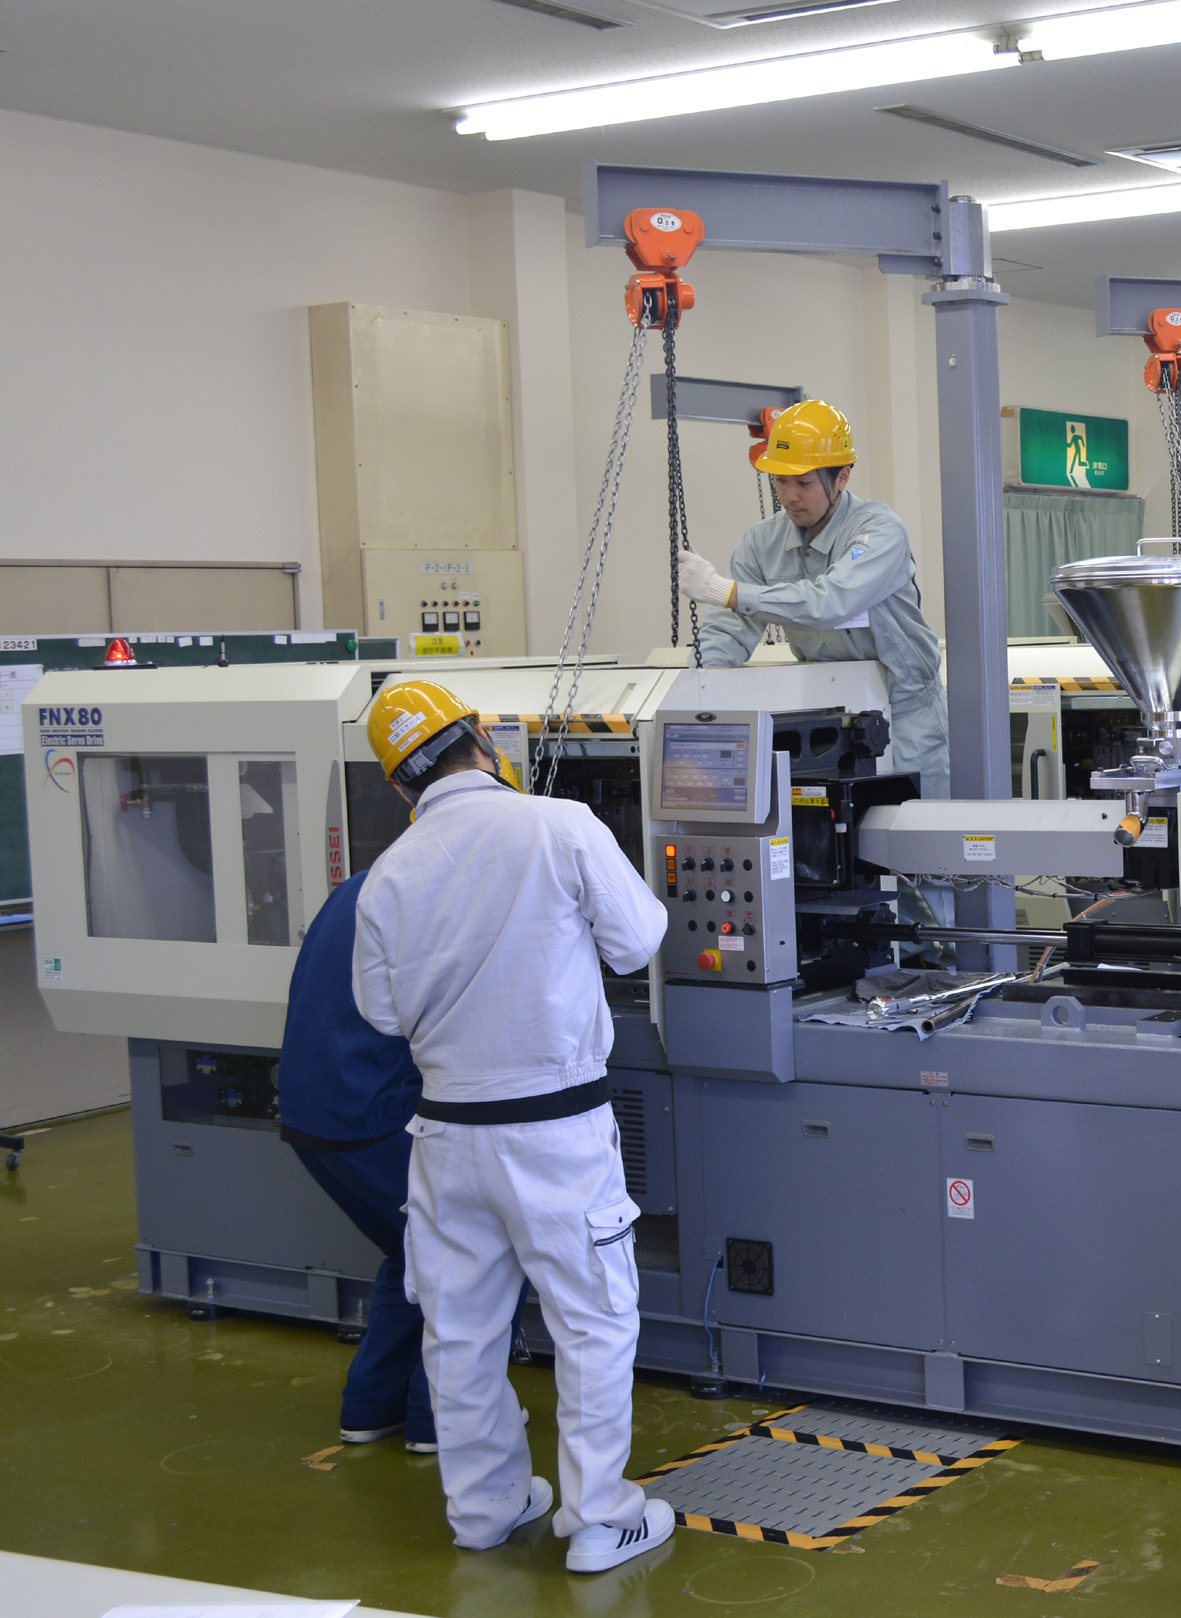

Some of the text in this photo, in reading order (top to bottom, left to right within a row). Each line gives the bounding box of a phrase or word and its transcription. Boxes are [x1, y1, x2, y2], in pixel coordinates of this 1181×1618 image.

[39, 707, 103, 726] FNX80
[42, 735, 104, 746] Electric Servo Drive
[328, 827, 343, 887] ISSEI
